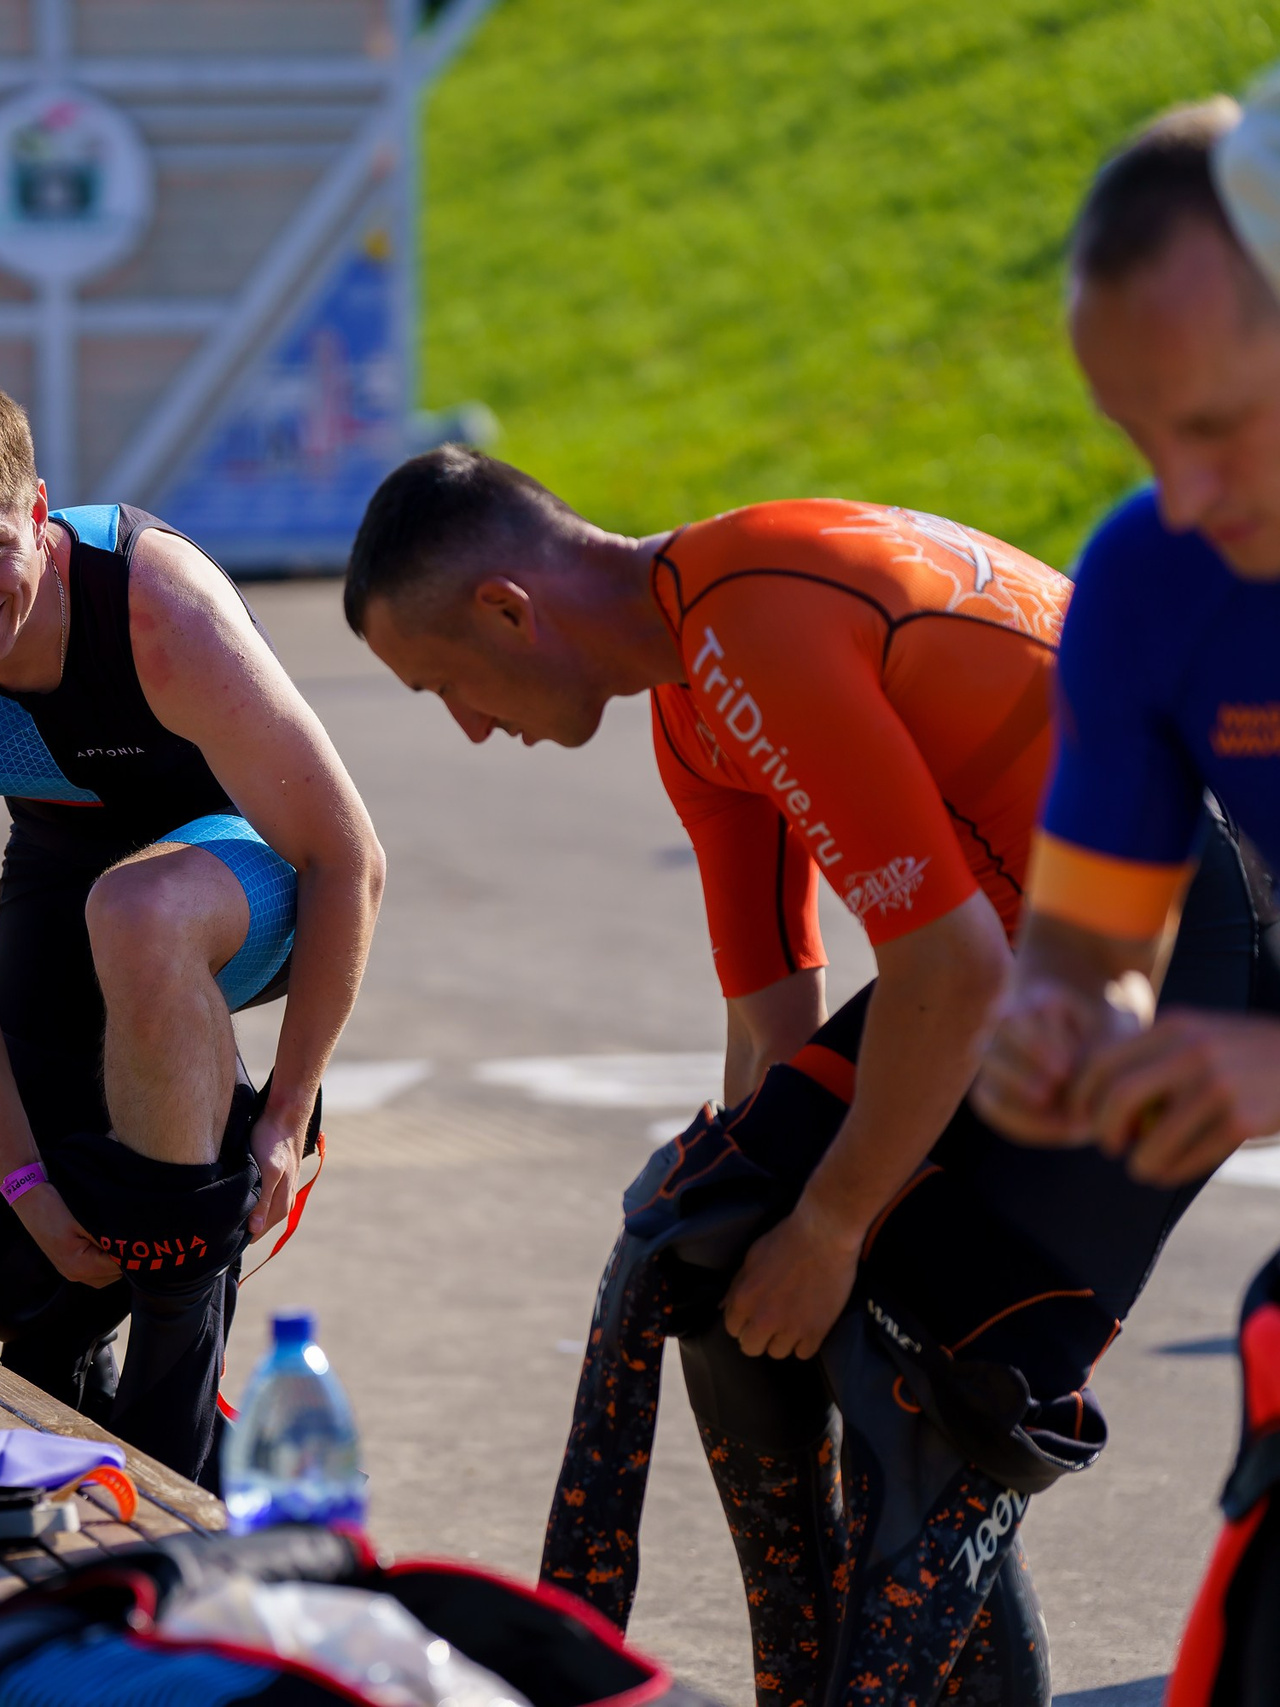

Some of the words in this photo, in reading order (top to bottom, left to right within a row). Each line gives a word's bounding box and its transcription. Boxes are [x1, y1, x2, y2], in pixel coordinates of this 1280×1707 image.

[77, 746, 145, 758] APTONIA
[692, 625, 844, 867] TriDrive.ru
[100, 1234, 206, 1259] PTONIA
